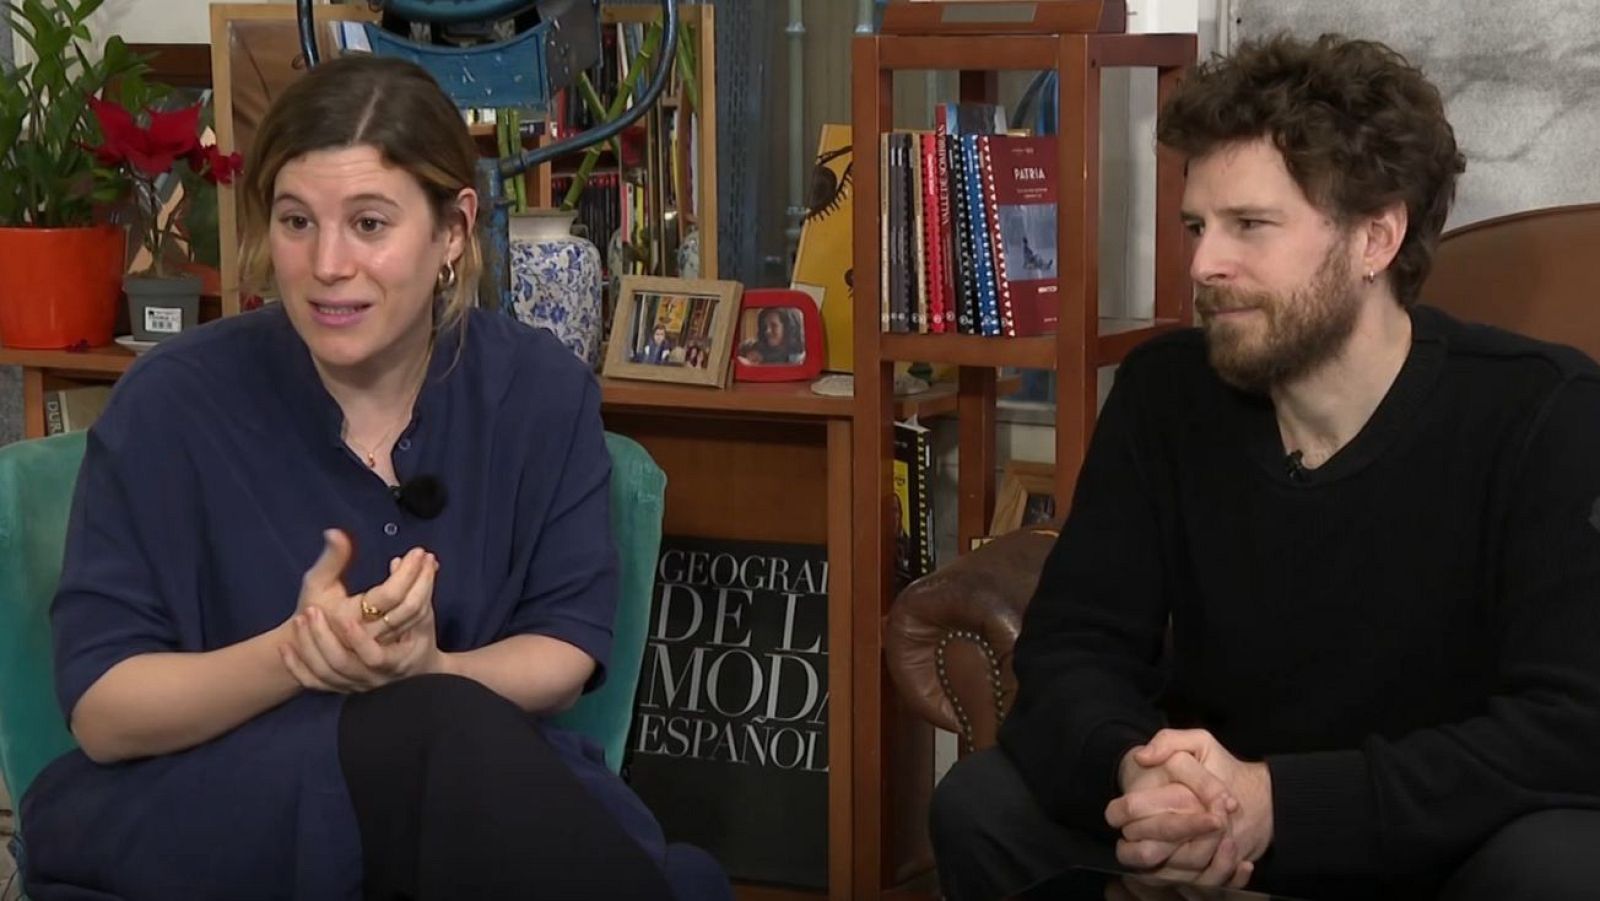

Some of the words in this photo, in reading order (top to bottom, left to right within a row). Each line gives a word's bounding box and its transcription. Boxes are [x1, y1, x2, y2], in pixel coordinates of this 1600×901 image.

[1013, 167, 1046, 180] PATRIA
[940, 194, 950, 225] VALLE
[649, 582, 753, 647] DE
[775, 591, 829, 655] L
